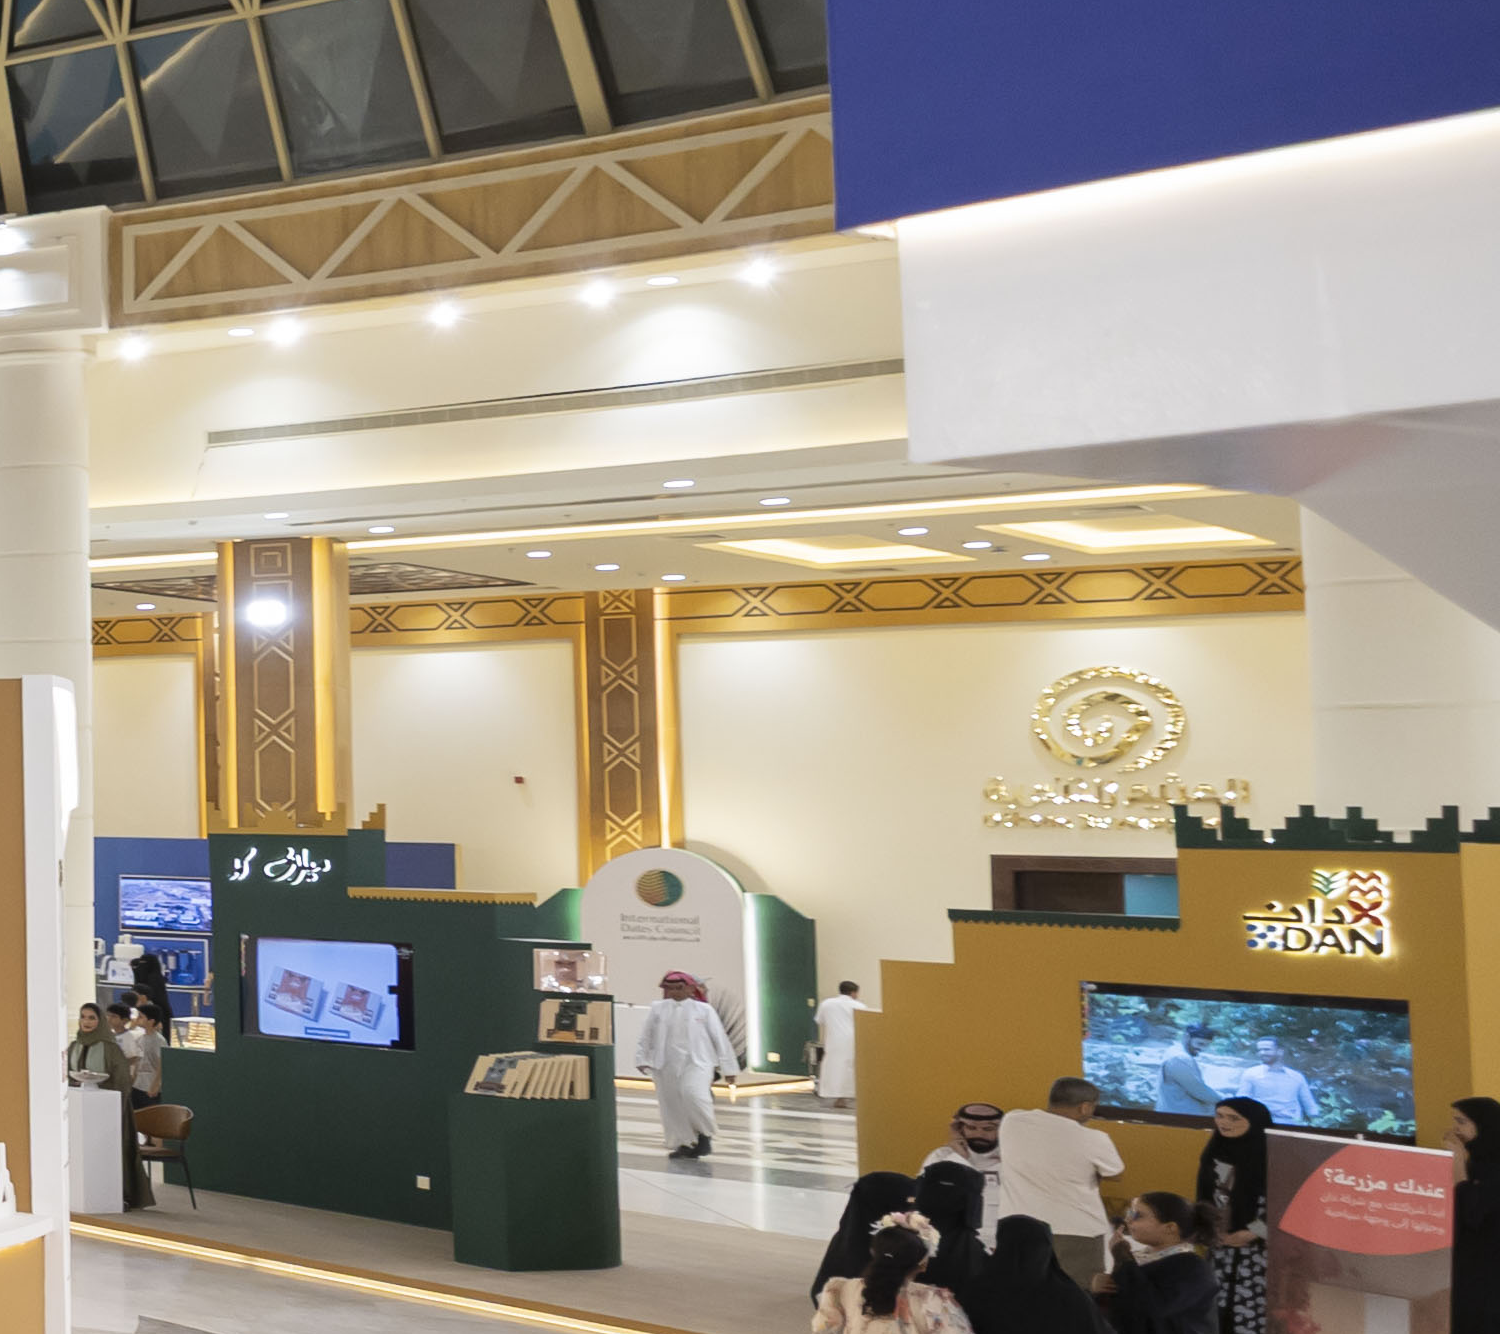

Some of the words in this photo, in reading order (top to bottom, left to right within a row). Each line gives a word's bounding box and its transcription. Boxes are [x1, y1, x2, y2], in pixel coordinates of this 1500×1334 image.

[1282, 927, 1383, 955] DAN
[1323, 1168, 1388, 1192] مزرعة؟
[1393, 1179, 1445, 1199] عندك
